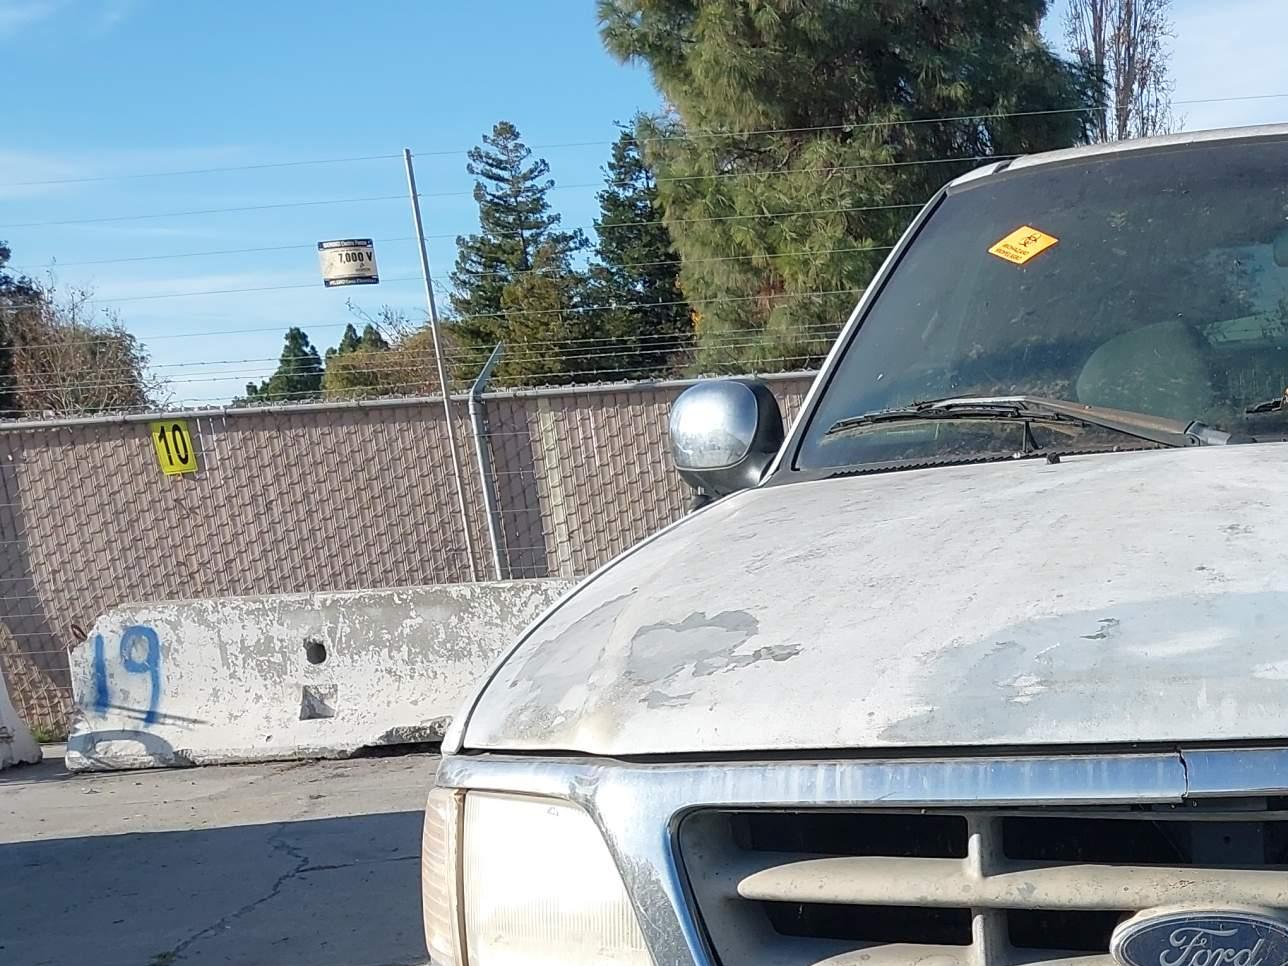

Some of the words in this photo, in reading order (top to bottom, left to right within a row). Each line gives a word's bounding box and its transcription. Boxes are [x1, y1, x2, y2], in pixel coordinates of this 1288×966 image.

[338, 252, 364, 264] 7,000
[366, 251, 373, 261] V
[156, 424, 190, 467] 10
[90, 625, 163, 727] 19
